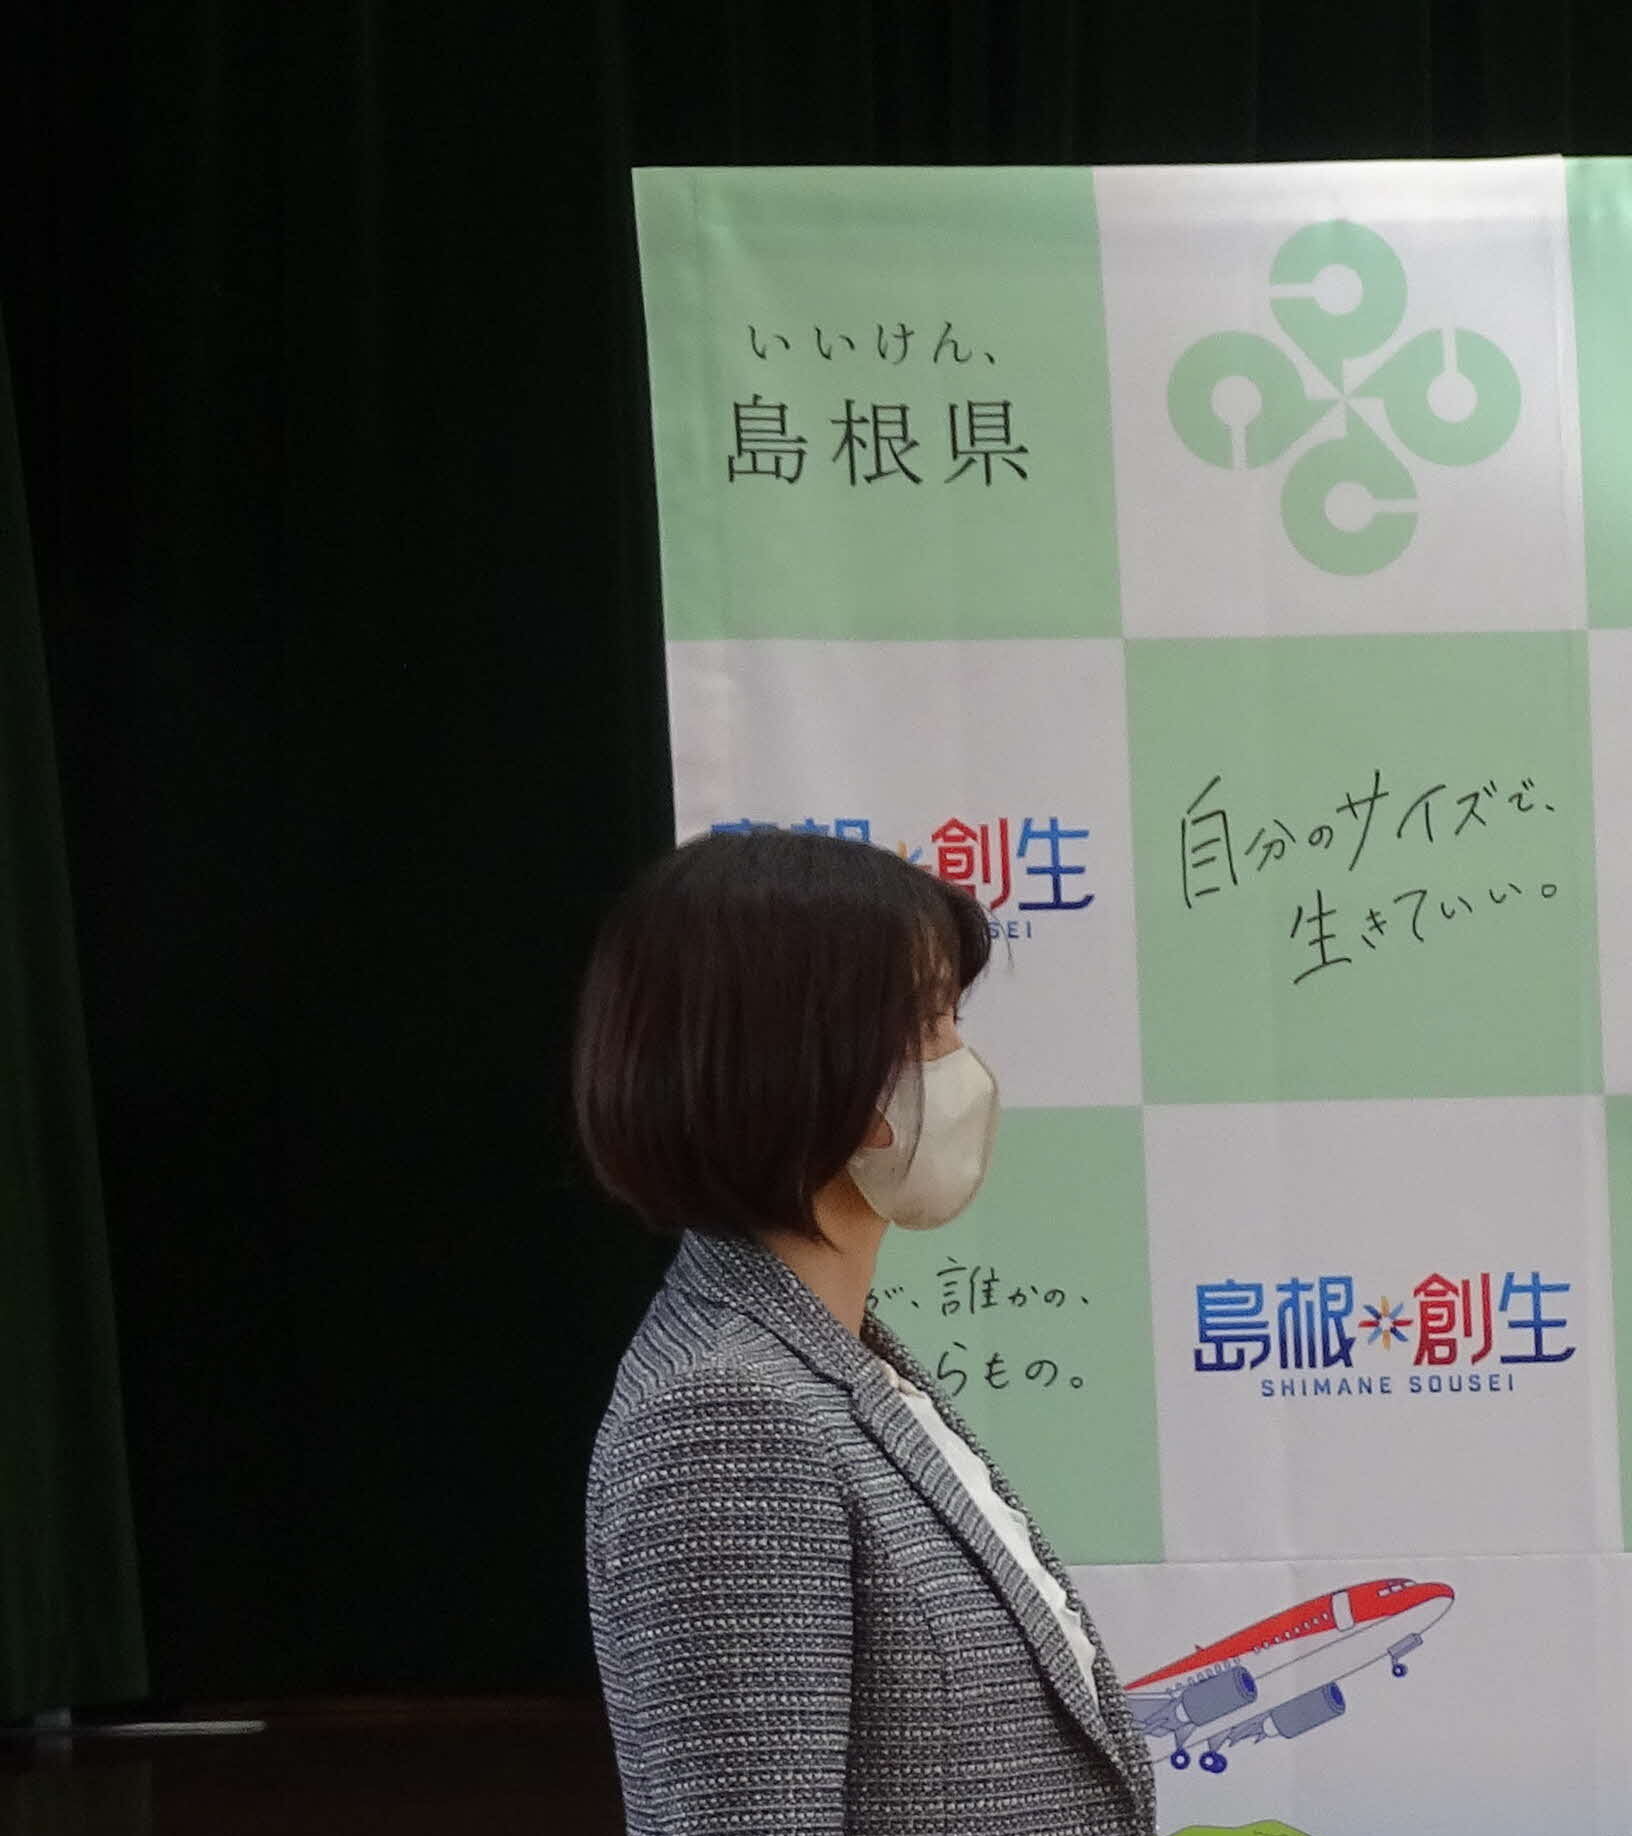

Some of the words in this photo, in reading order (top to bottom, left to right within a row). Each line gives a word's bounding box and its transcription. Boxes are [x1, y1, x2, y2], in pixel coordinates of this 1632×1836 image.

[748, 321, 995, 365] いいけん、
[728, 394, 1028, 486] 島根県
[711, 817, 1095, 911] 創生
[1181, 769, 1557, 909] 自分のサイズで、
[987, 921, 1032, 940] SEI
[1290, 887, 1557, 985] 生きていい。
[1261, 1376, 1392, 1397] SHIMANE
[1409, 1374, 1513, 1394] SOUSEI
